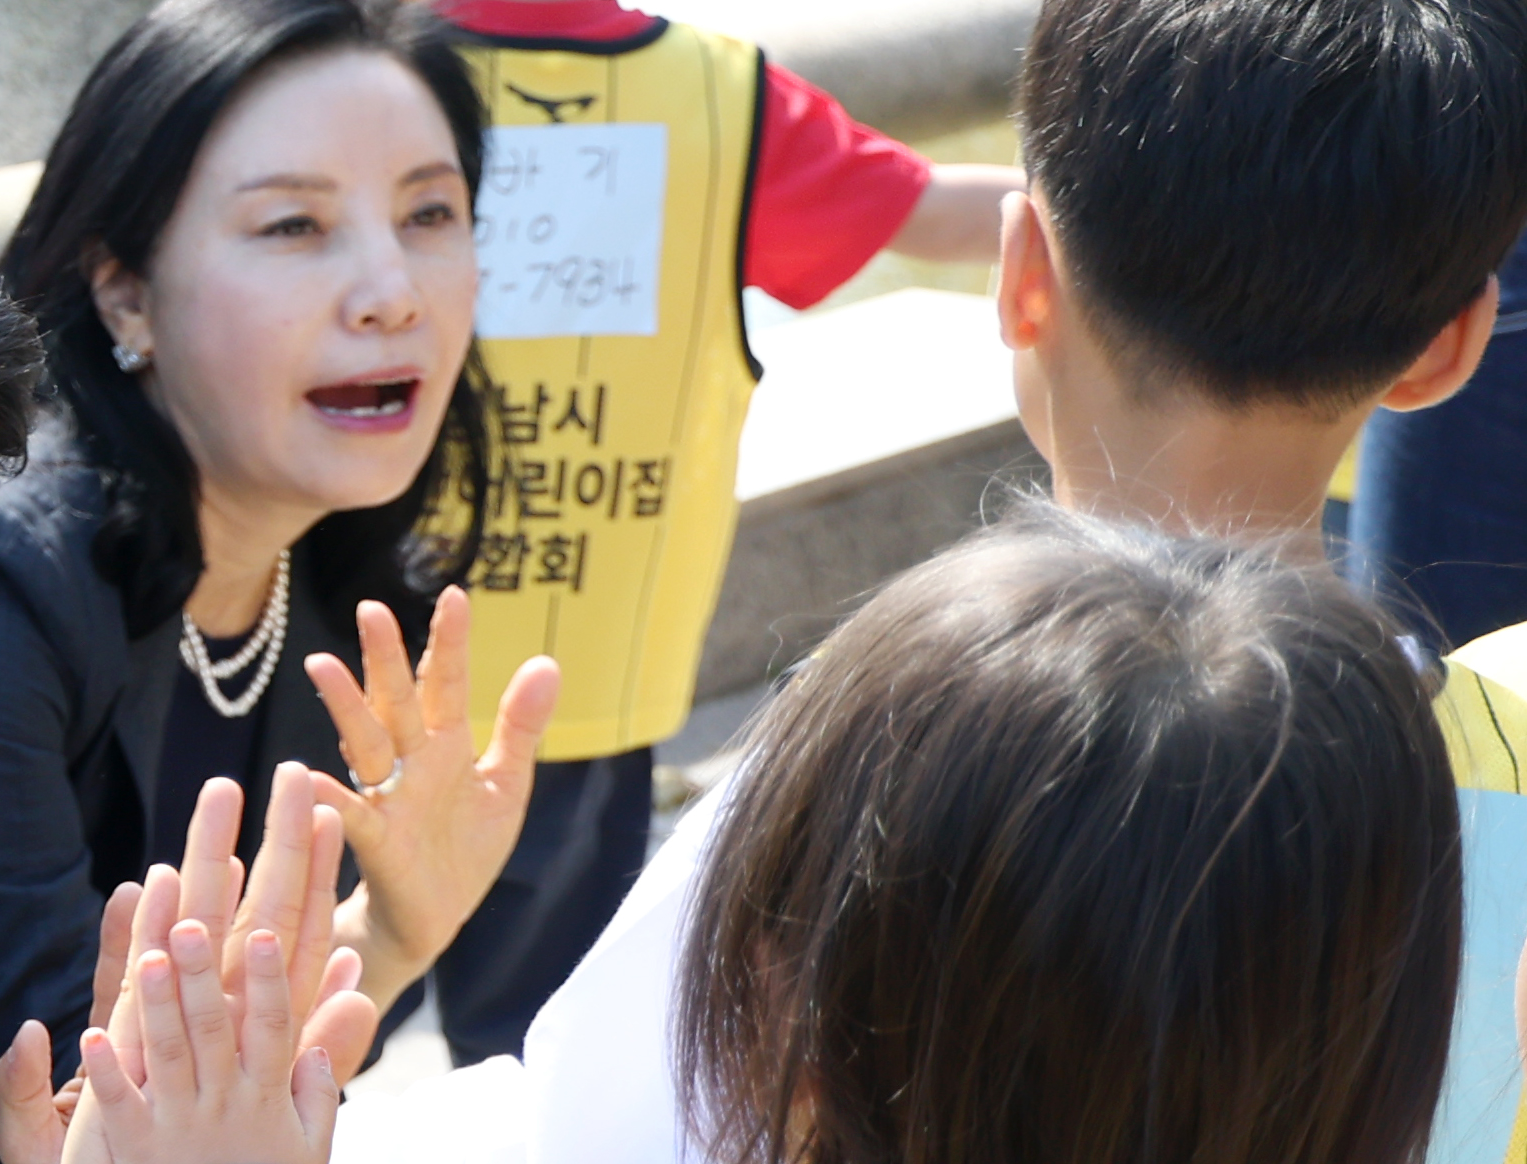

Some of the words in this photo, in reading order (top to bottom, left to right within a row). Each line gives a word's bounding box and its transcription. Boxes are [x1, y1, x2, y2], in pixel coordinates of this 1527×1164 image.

[476, 254, 642, 308] -7934
[485, 383, 606, 447] 남시
[458, 455, 672, 521] 어린이집
[476, 532, 589, 593] 합회
